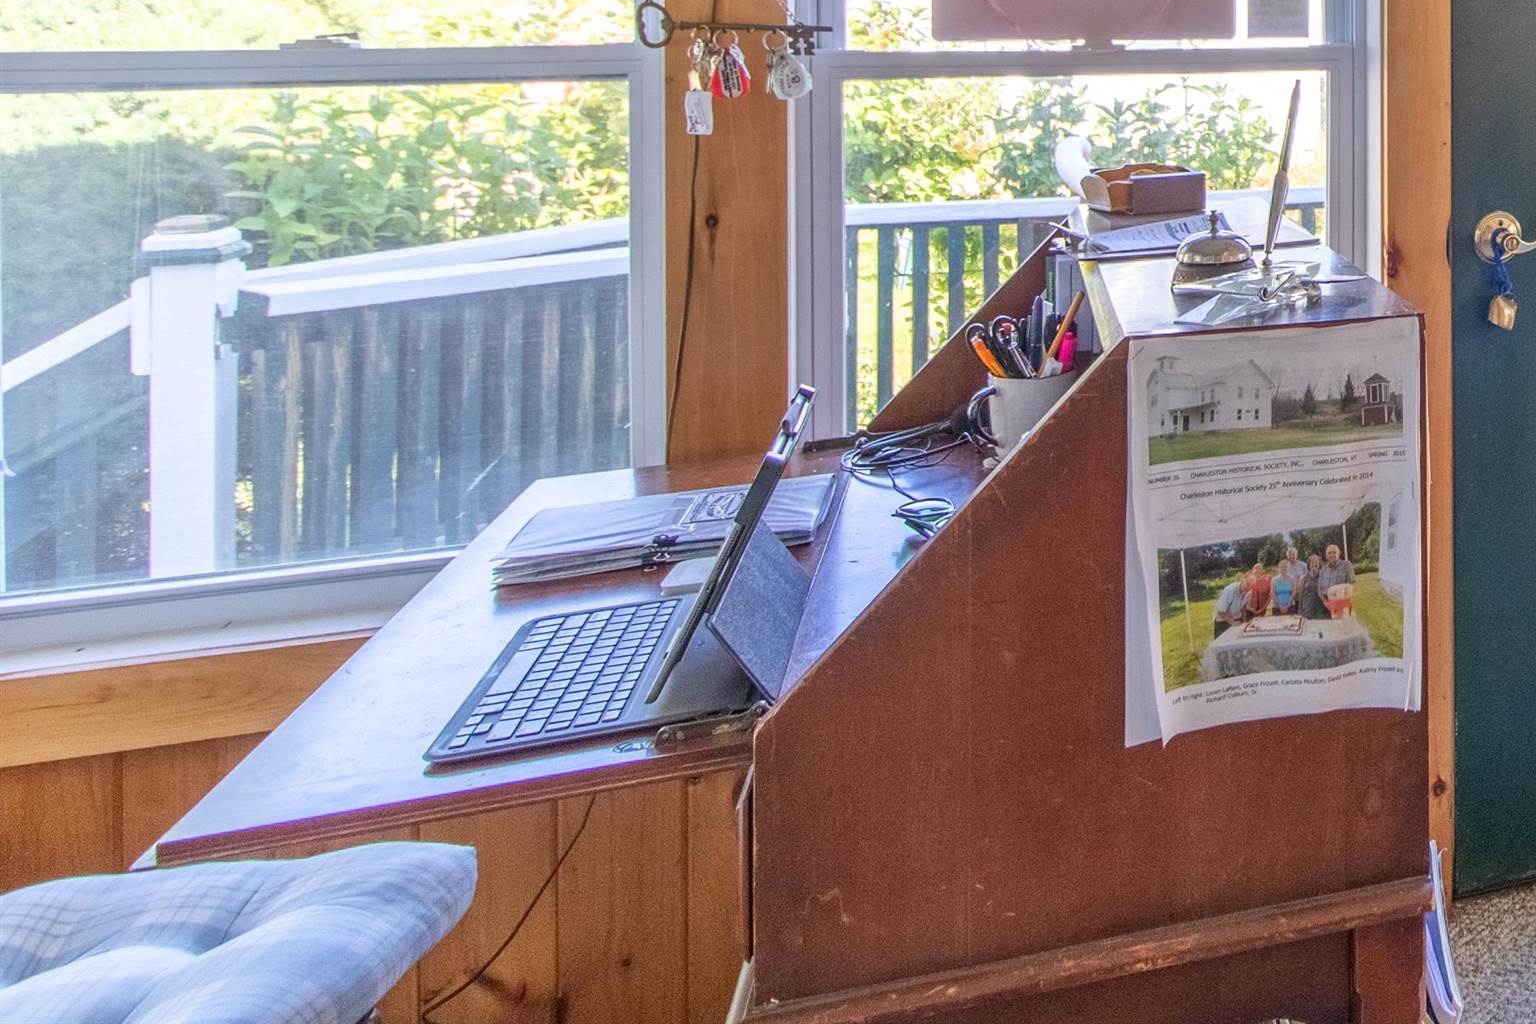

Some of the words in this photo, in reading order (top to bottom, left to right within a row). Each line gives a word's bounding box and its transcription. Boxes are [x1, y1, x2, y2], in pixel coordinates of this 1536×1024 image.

[1190, 468, 1228, 479] CHARLESTON
[1228, 464, 1262, 475] HISTORICAL
[1180, 489, 1214, 501] Charleston
[1214, 485, 1243, 496] Historical
[1244, 482, 1268, 492] Society
[1282, 478, 1319, 489] Anniversary
[1319, 475, 1352, 486] Celebrated
